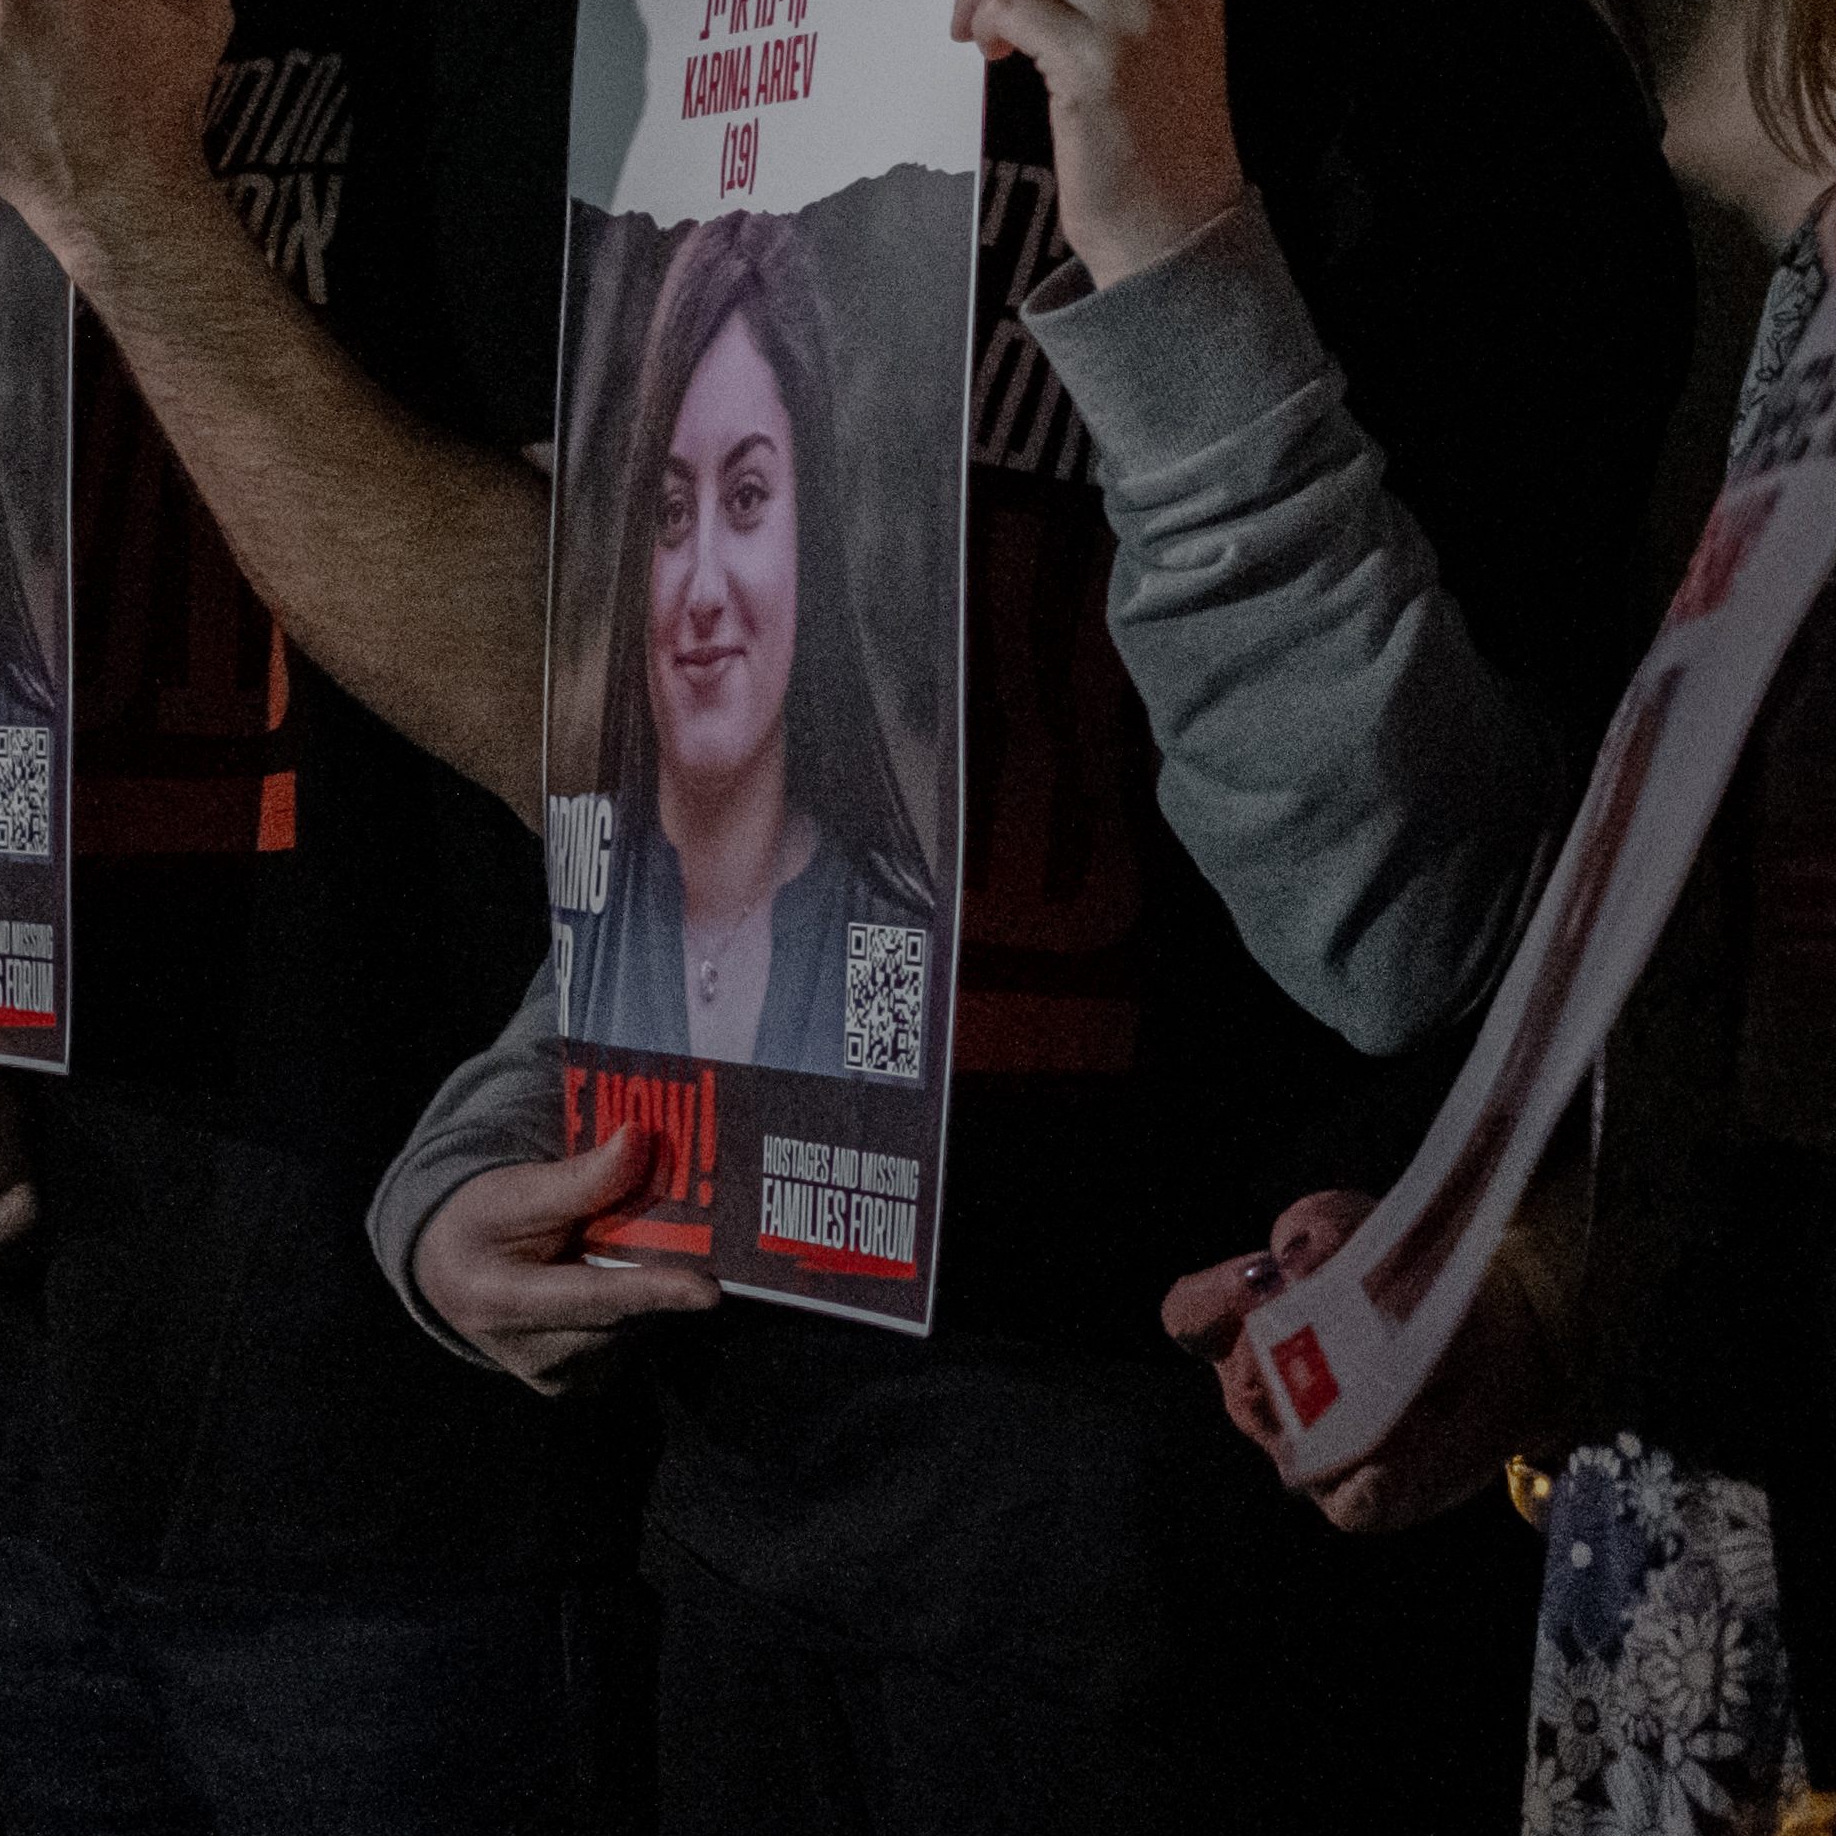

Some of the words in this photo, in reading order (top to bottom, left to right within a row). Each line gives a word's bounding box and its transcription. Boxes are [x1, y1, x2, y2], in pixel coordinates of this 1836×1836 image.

[681, 45, 751, 120] KARINA
[755, 31, 818, 107] ARIEV
[720, 117, 758, 199] (19)
[5, 958, 54, 1014] FORUM
[763, 1134, 831, 1184] HOSTAGES
[831, 1146, 860, 1189] AND
[860, 1151, 920, 1201] MISSING
[761, 1177, 847, 1249] FAMILIES
[849, 1193, 917, 1263] FORUM
